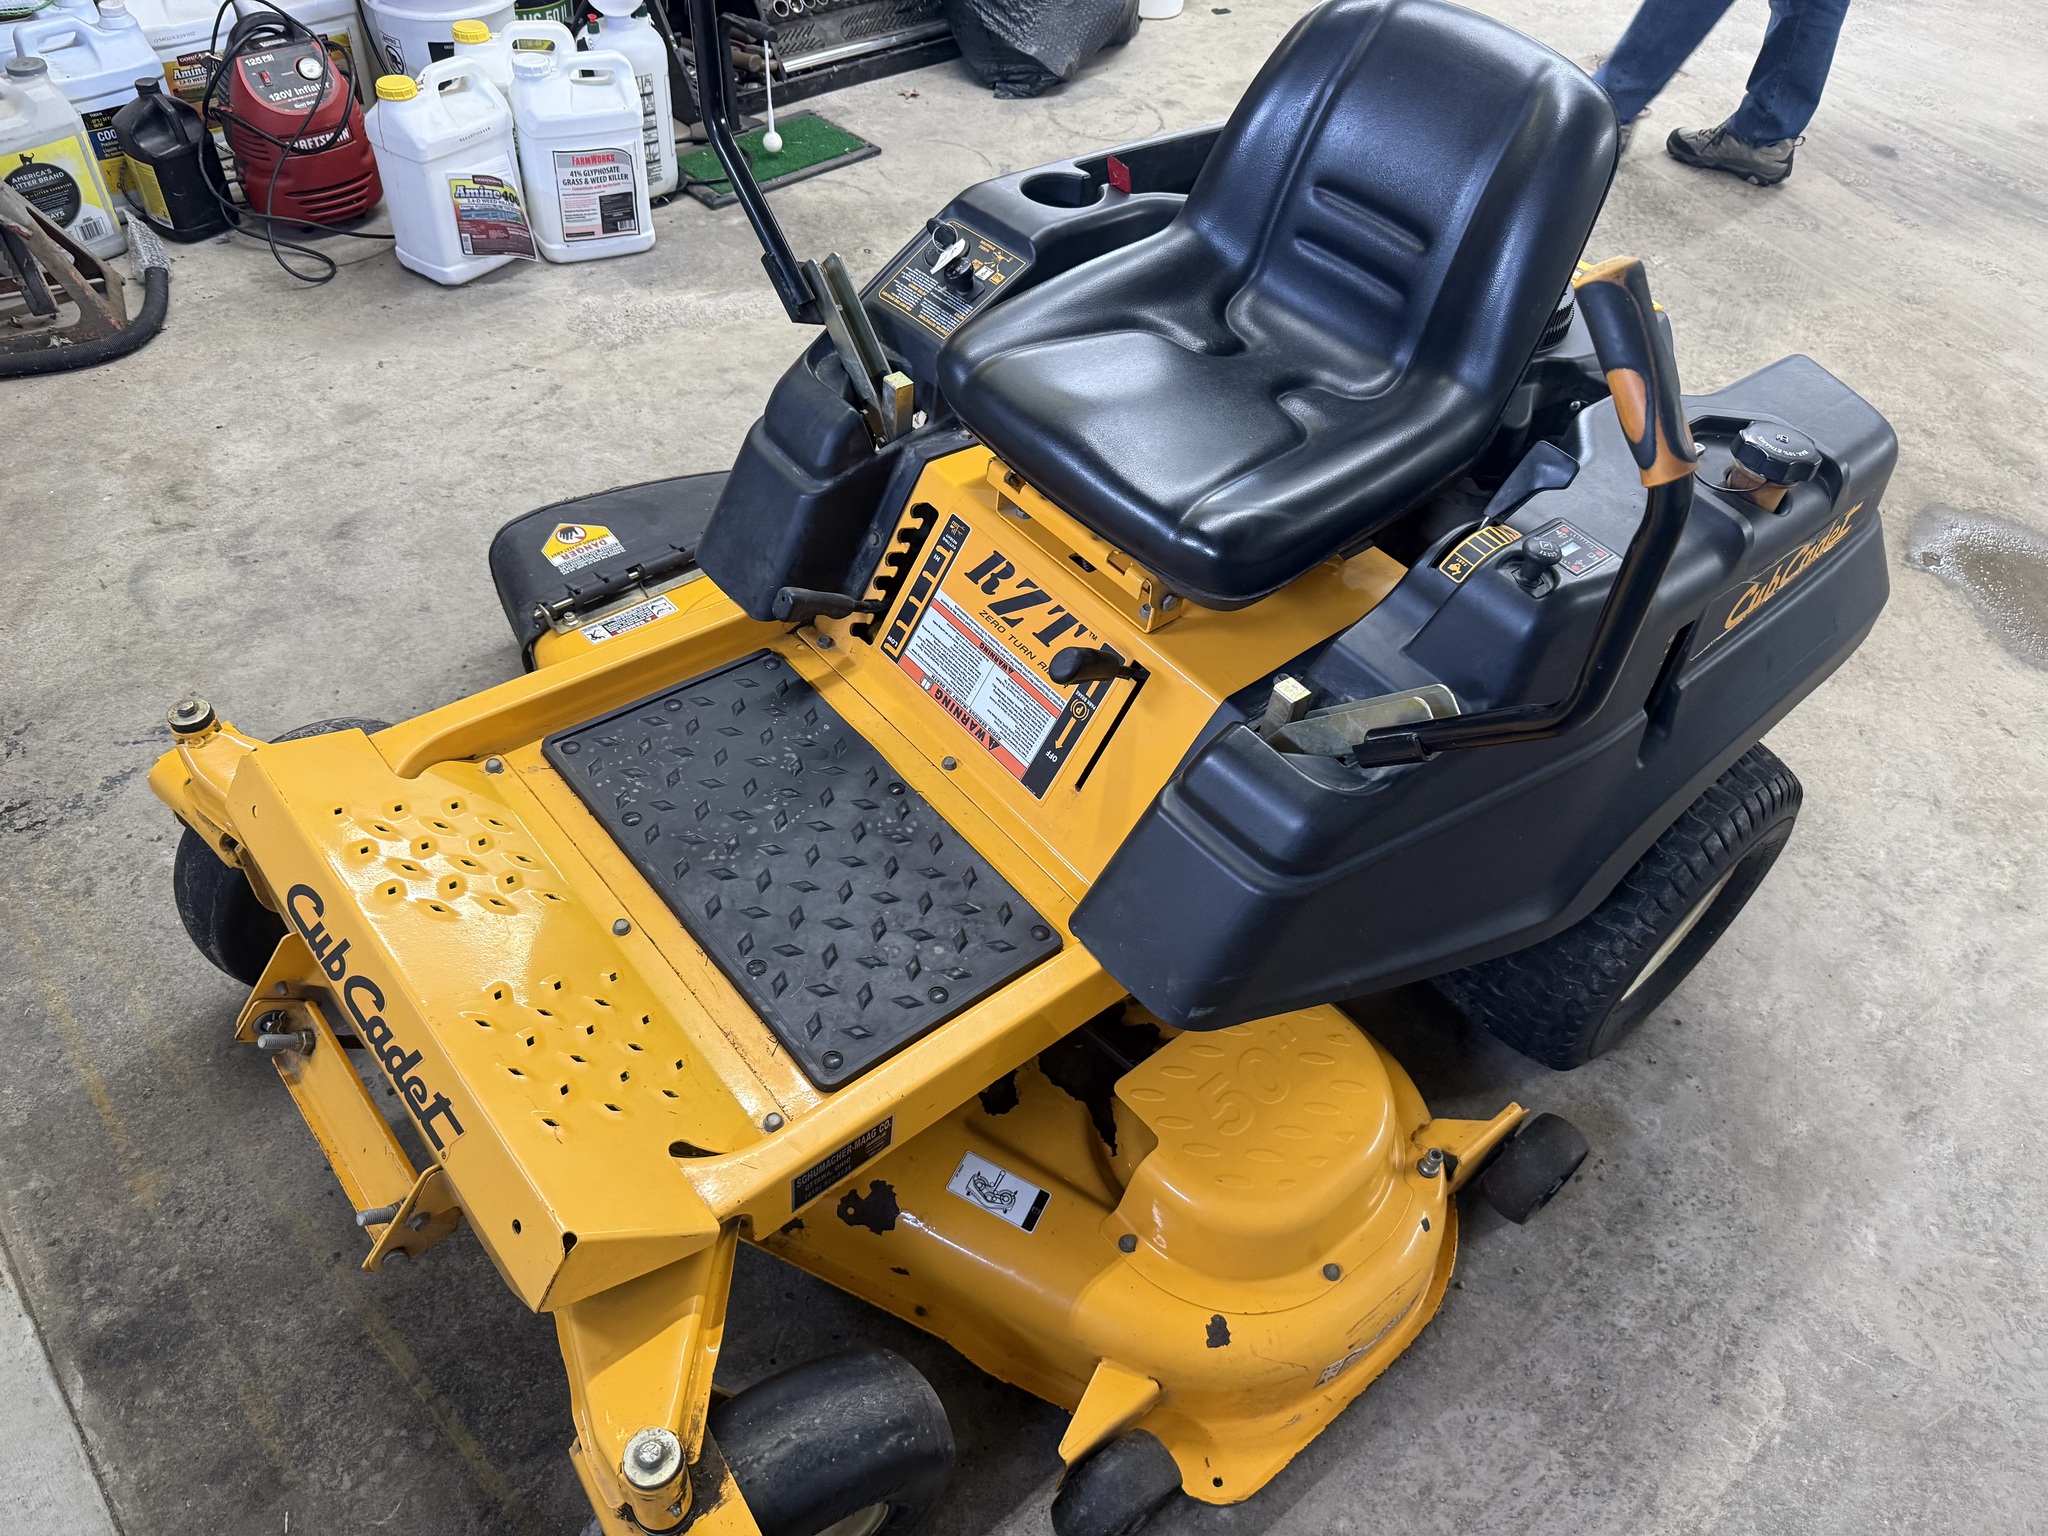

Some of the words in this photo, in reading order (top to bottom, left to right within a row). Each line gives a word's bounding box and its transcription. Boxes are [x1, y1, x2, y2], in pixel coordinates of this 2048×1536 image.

[245, 57, 262, 67] 125
[269, 90, 292, 102] 120V
[294, 81, 330, 96] Inflatr
[12, 168, 53, 184] AMERICA'S
[38, 172, 65, 183] BRAND
[562, 178, 583, 186] GRASS
[584, 177, 590, 185] &
[590, 176, 608, 185] WEED
[608, 173, 629, 182] KILLER
[583, 166, 620, 177] GLYPHOSATE
[455, 185, 500, 199] Amine
[502, 191, 521, 207] 400
[561, 540, 608, 561] DANGER
[933, 554, 941, 562] HI
[1725, 564, 1783, 630] Cub
[1781, 501, 1864, 587] Cadet
[964, 550, 1089, 648] RZT
[887, 635, 898, 647] LOW
[979, 610, 1006, 634] ZERO
[1008, 634, 1037, 660] TURN
[979, 642, 1008, 671] WARNING
[930, 673, 945, 689] DEATH
[952, 693, 968, 710] INJURY
[934, 689, 987, 742] WARNING
[1045, 750, 1058, 763] OFF
[287, 883, 351, 982] Cub
[344, 975, 465, 1151] Cadet
[796, 1128, 877, 1188] SCHUMACHER-MAAG
[879, 1119, 892, 1133] CO.
[835, 1156, 851, 1171] OHIO
